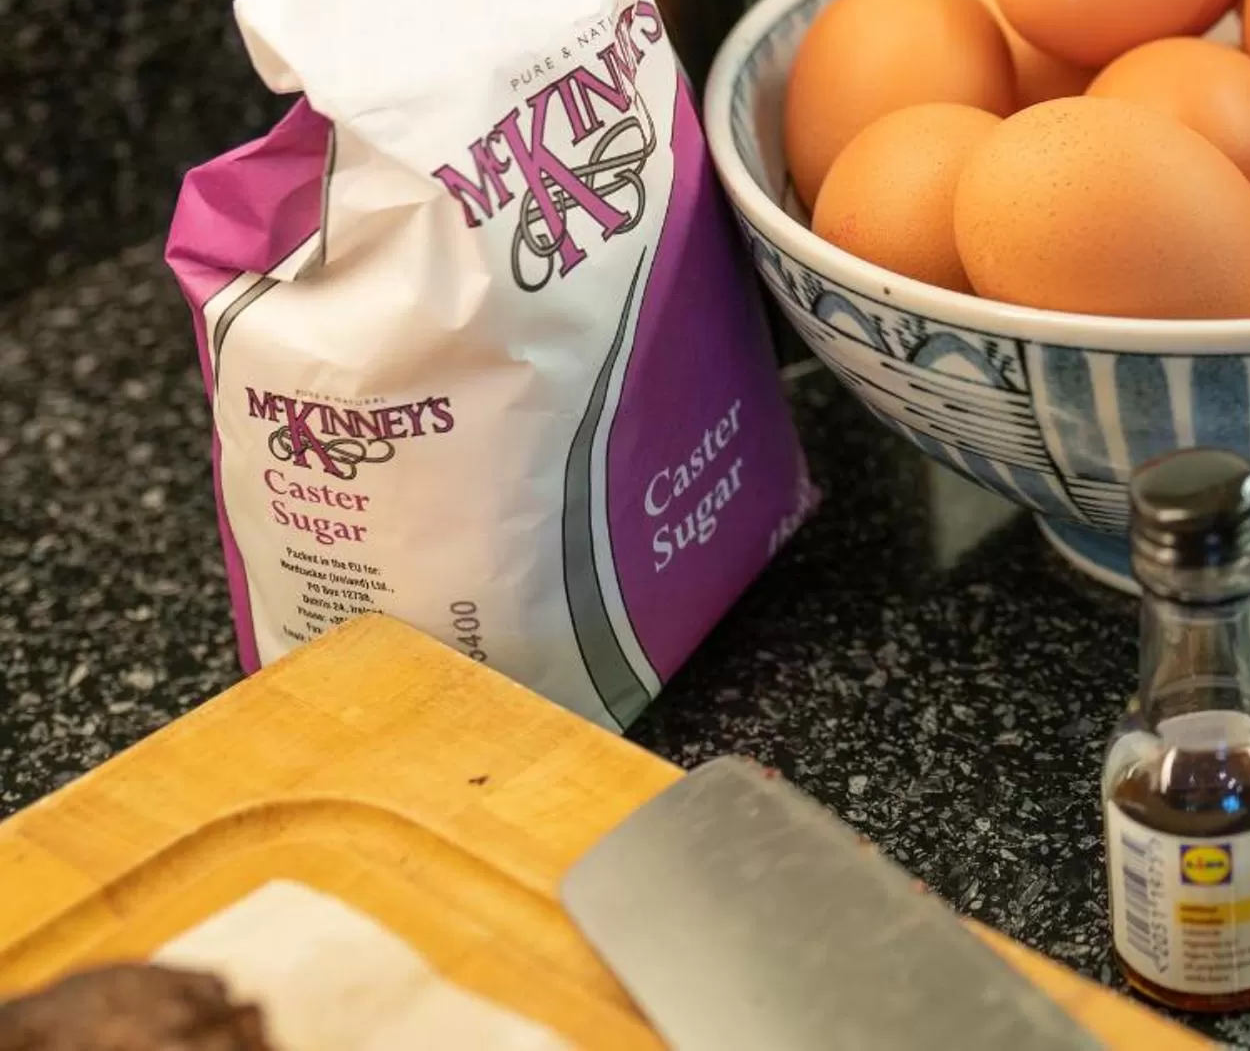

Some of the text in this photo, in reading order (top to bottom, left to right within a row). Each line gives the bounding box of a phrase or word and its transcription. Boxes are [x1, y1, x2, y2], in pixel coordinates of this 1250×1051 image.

[509, 56, 555, 91] PURE
[560, 46, 573, 60] &
[641, 398, 742, 516] Caster
[263, 468, 370, 511] Caster
[271, 499, 367, 546] Sugar
[652, 456, 743, 573] Sugar
[331, 558, 346, 570] the
